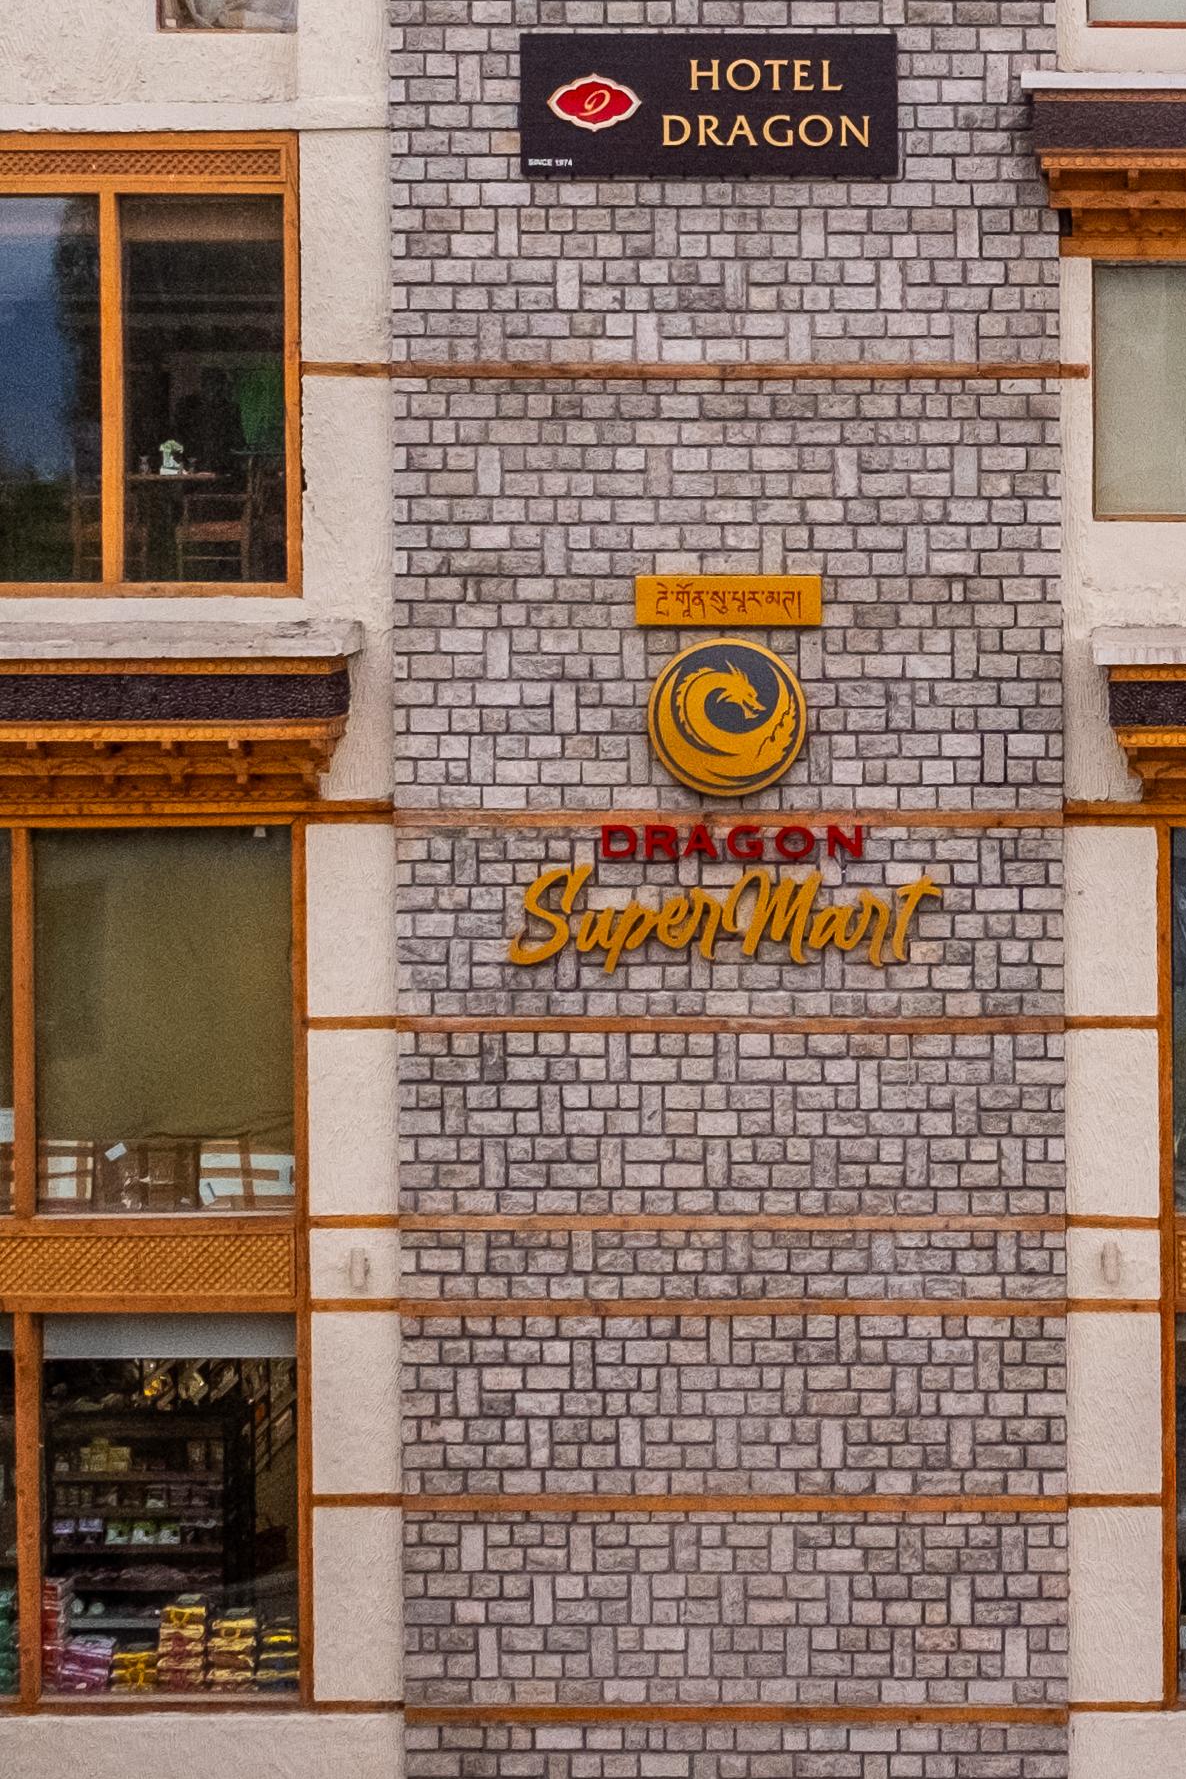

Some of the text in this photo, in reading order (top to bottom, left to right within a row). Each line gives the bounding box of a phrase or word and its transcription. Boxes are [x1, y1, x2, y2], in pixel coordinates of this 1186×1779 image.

[689, 59, 843, 92] HOTEL
[662, 114, 871, 148] DRAGON
[601, 824, 863, 860] DRAGON
